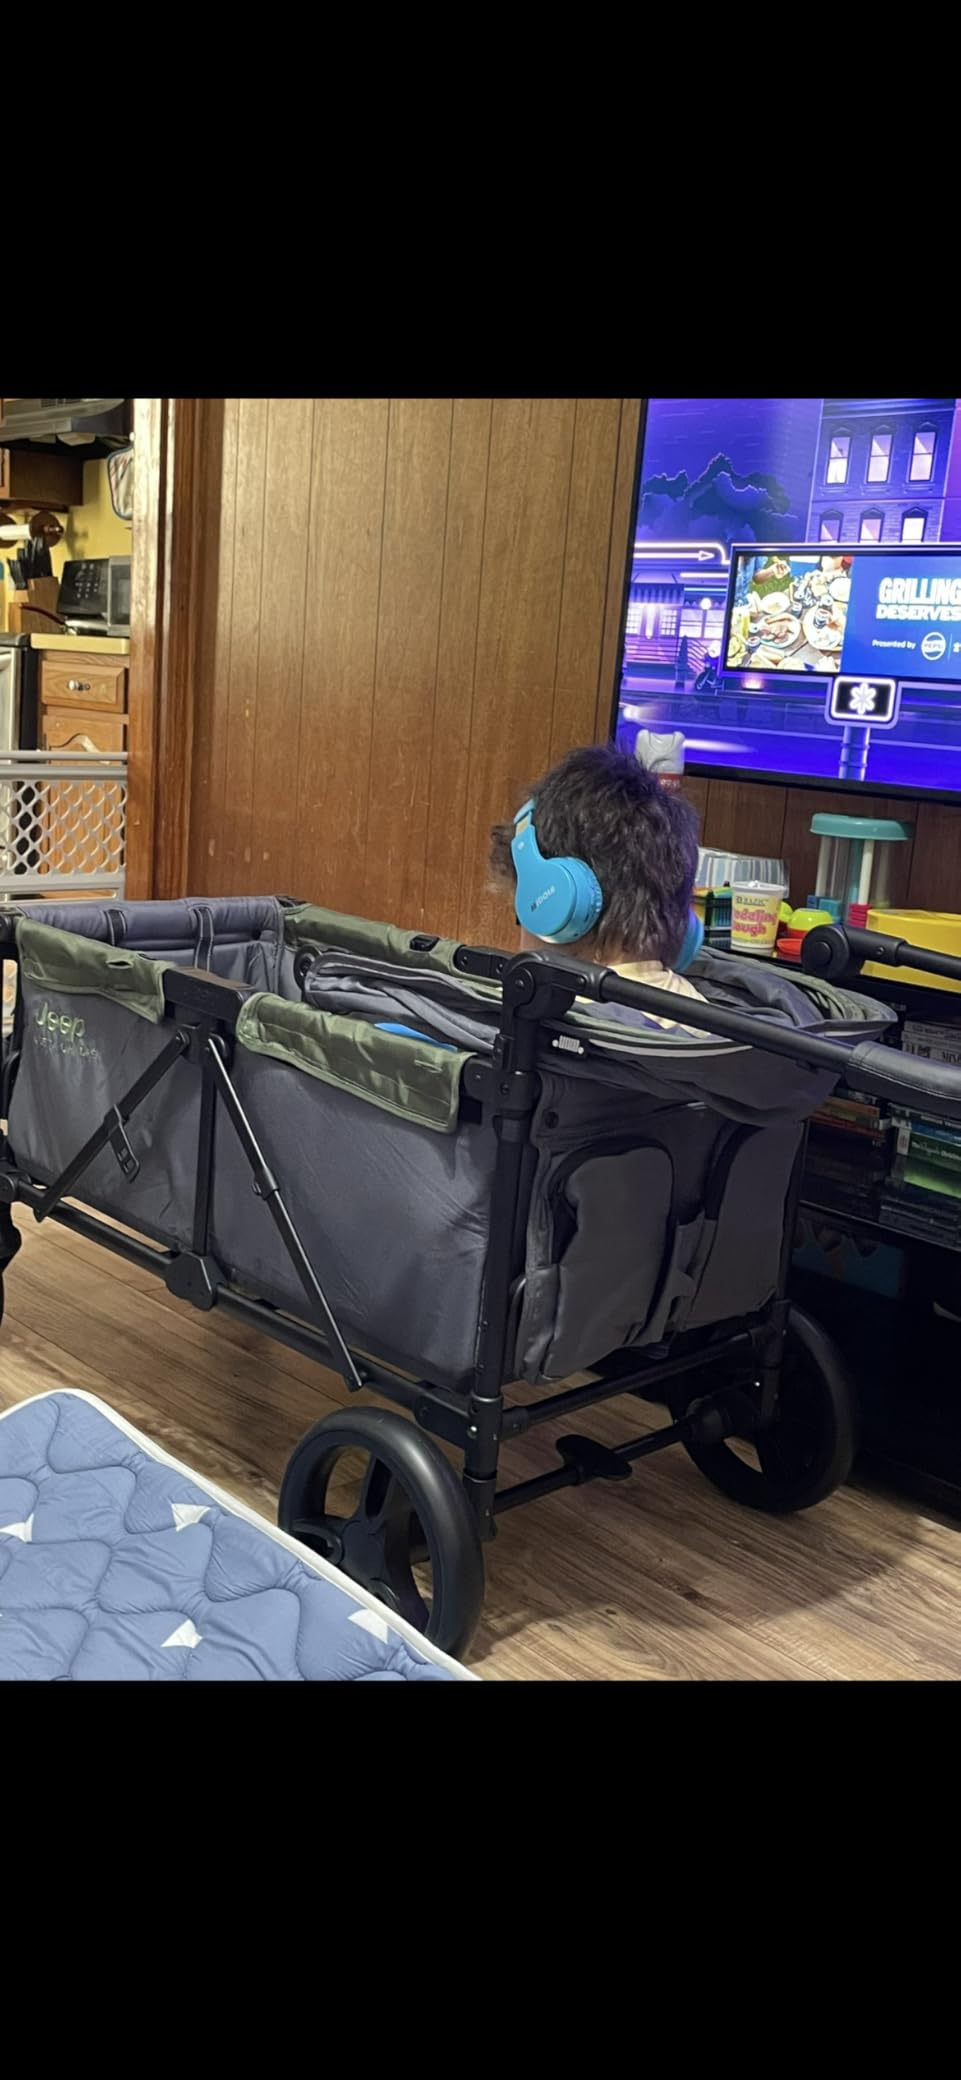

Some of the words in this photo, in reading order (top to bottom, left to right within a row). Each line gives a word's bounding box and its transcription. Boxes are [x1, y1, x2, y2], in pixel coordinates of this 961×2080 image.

[879, 576, 961, 605] GRILLING
[875, 603, 961, 622] DESERVES
[872, 639, 906, 649] Presented
[907, 640, 916, 650] by
[35, 1001, 86, 1042] Jeep
